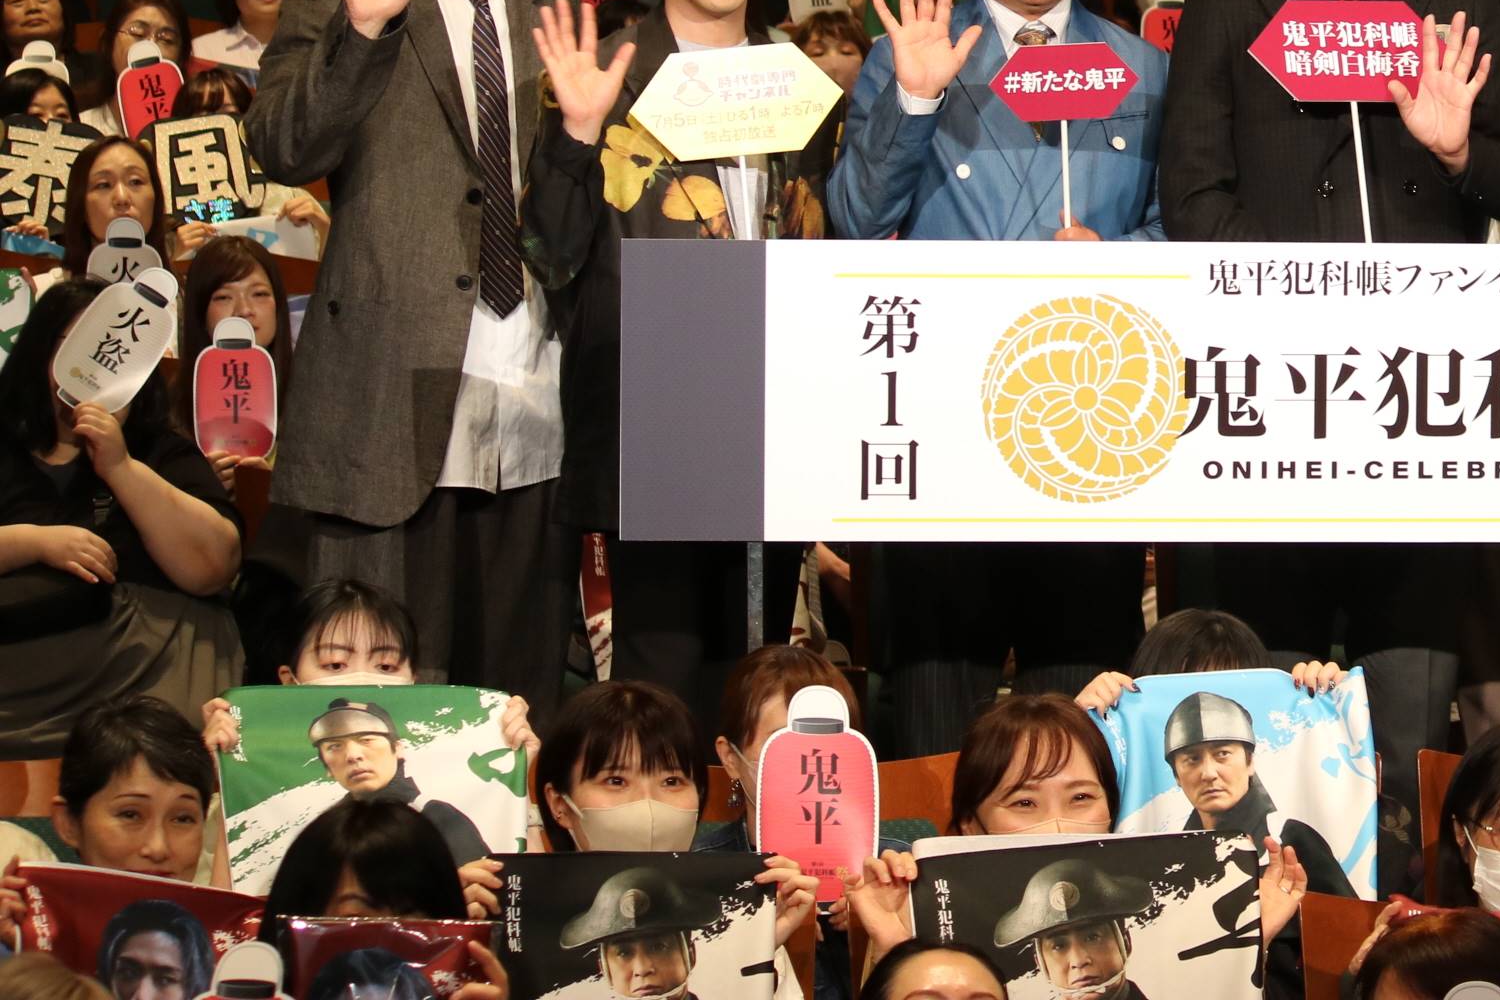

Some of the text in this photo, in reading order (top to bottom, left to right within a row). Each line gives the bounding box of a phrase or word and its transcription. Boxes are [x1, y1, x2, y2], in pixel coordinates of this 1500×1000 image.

[1282, 20, 1419, 50] 鬼平犯科帳
[1284, 48, 1421, 80] 暗剣白梅香
[1005, 66, 1127, 94] #新たな鬼平
[154, 114, 264, 216] 風
[88, 306, 150, 375] 火盗
[221, 359, 253, 425] 鬼平
[859, 295, 921, 502] 第1回
[797, 749, 842, 845] 鬼平
[506, 875, 522, 953] 鬼平犯科帳
[934, 879, 954, 943] 鬼平犯科
